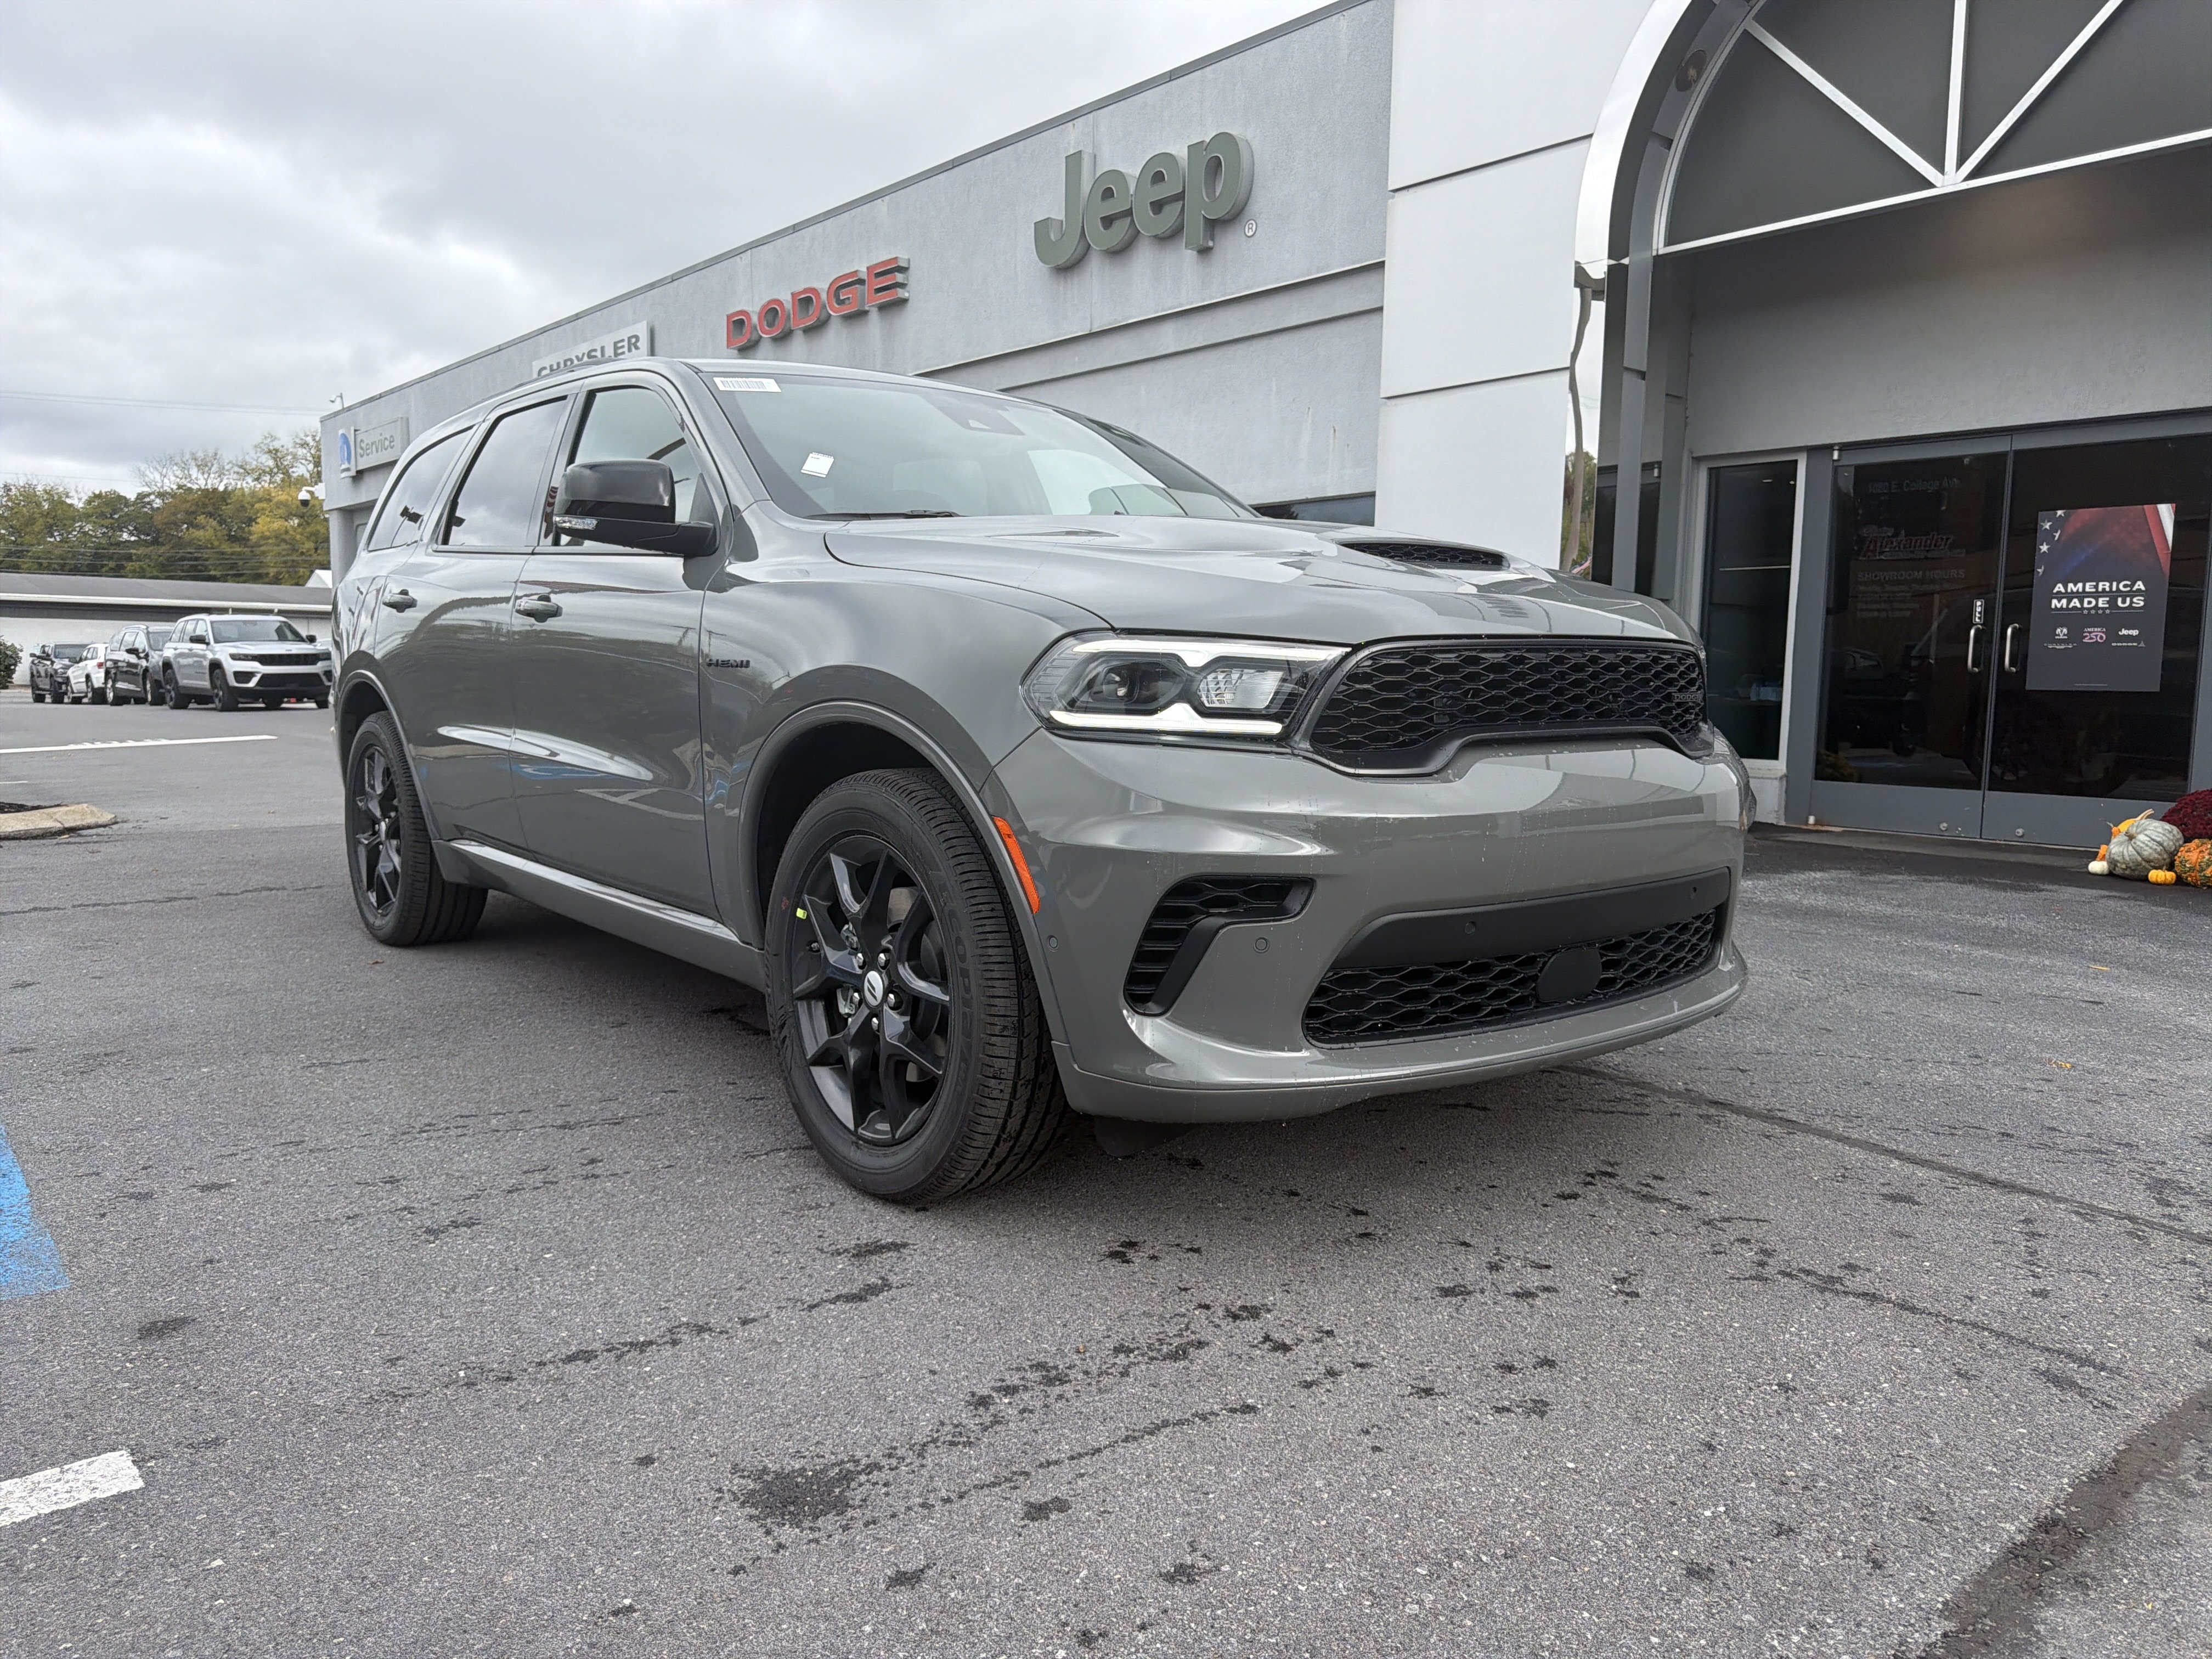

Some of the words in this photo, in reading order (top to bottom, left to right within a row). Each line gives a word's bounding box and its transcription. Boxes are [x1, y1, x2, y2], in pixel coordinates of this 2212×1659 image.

[1034, 131, 1254, 269] Jeep
[726, 256, 910, 351] DODGE
[359, 432, 396, 459] Service
[1860, 529, 1953, 559] Alexander
[1858, 571, 1923, 581] SHOWROOM
[1926, 569, 1966, 579] HOURS
[2052, 580, 2146, 593] AMERICA
[2051, 597, 2110, 609] MADE
[2117, 596, 2145, 607] US
[2083, 632, 2106, 642] 250
[2118, 628, 2139, 636] Jeep
